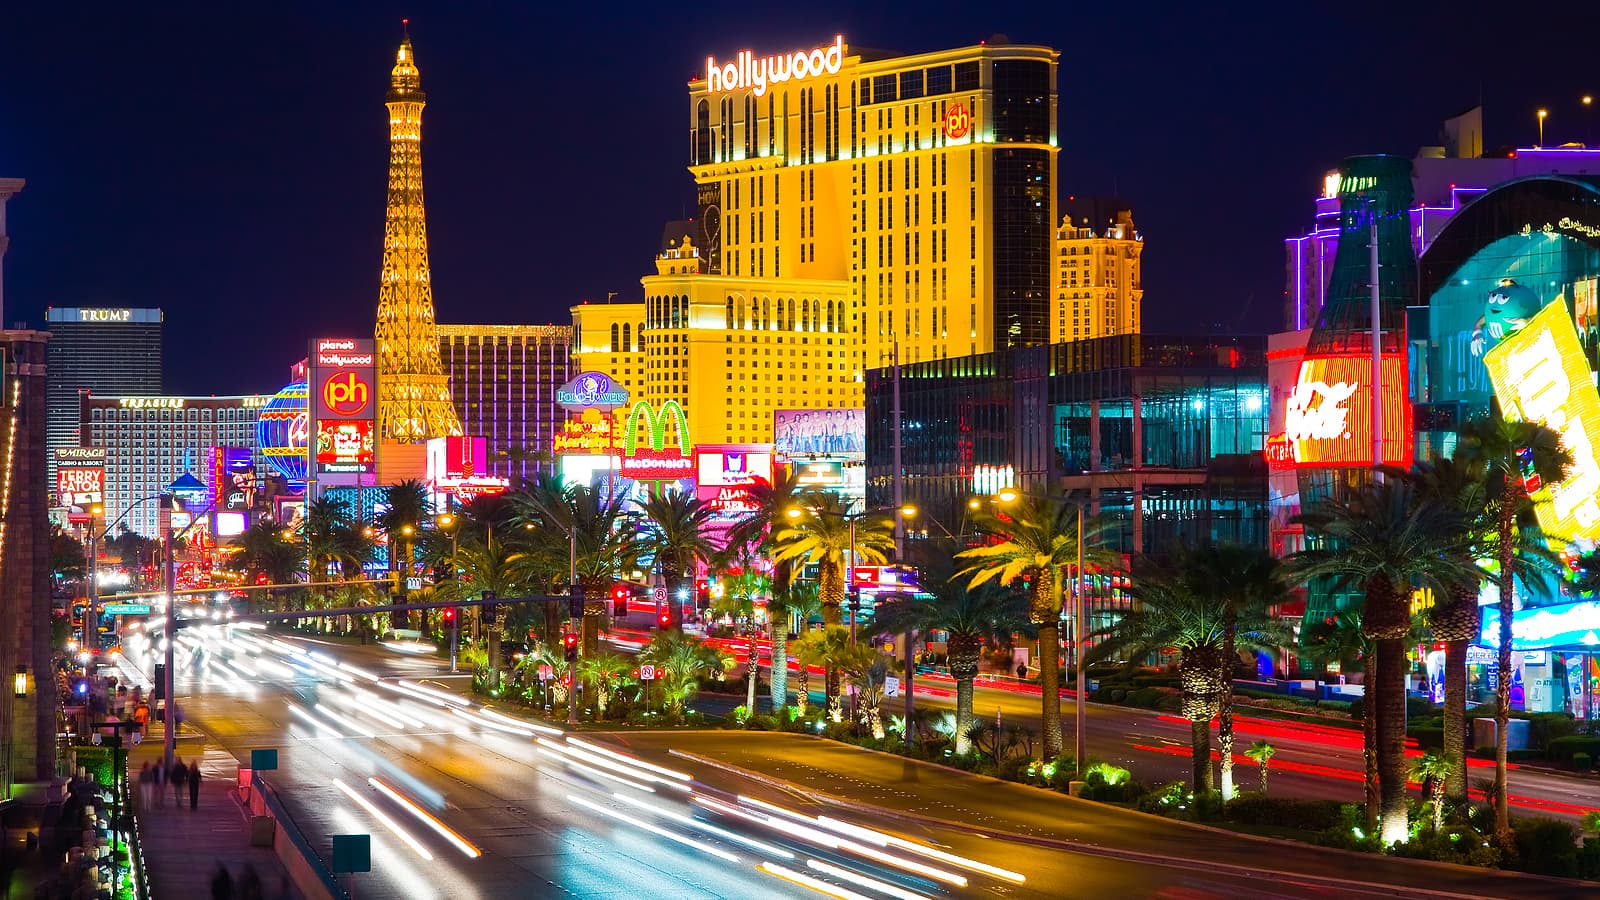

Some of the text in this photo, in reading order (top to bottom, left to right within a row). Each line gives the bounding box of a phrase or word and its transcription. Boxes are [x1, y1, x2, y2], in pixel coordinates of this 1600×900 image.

[707, 34, 842, 97] hollywood
[949, 105, 968, 135] ph
[80, 309, 130, 321] TRUMP
[320, 340, 354, 352] planet
[320, 354, 372, 366] hollywood
[328, 372, 367, 409] ph
[120, 398, 185, 408] TREASURE
[63, 448, 105, 458] MIRAGE
[625, 459, 692, 469] McDonald's
[59, 470, 101, 481] TERRY
[60, 481, 101, 492] FATOR
